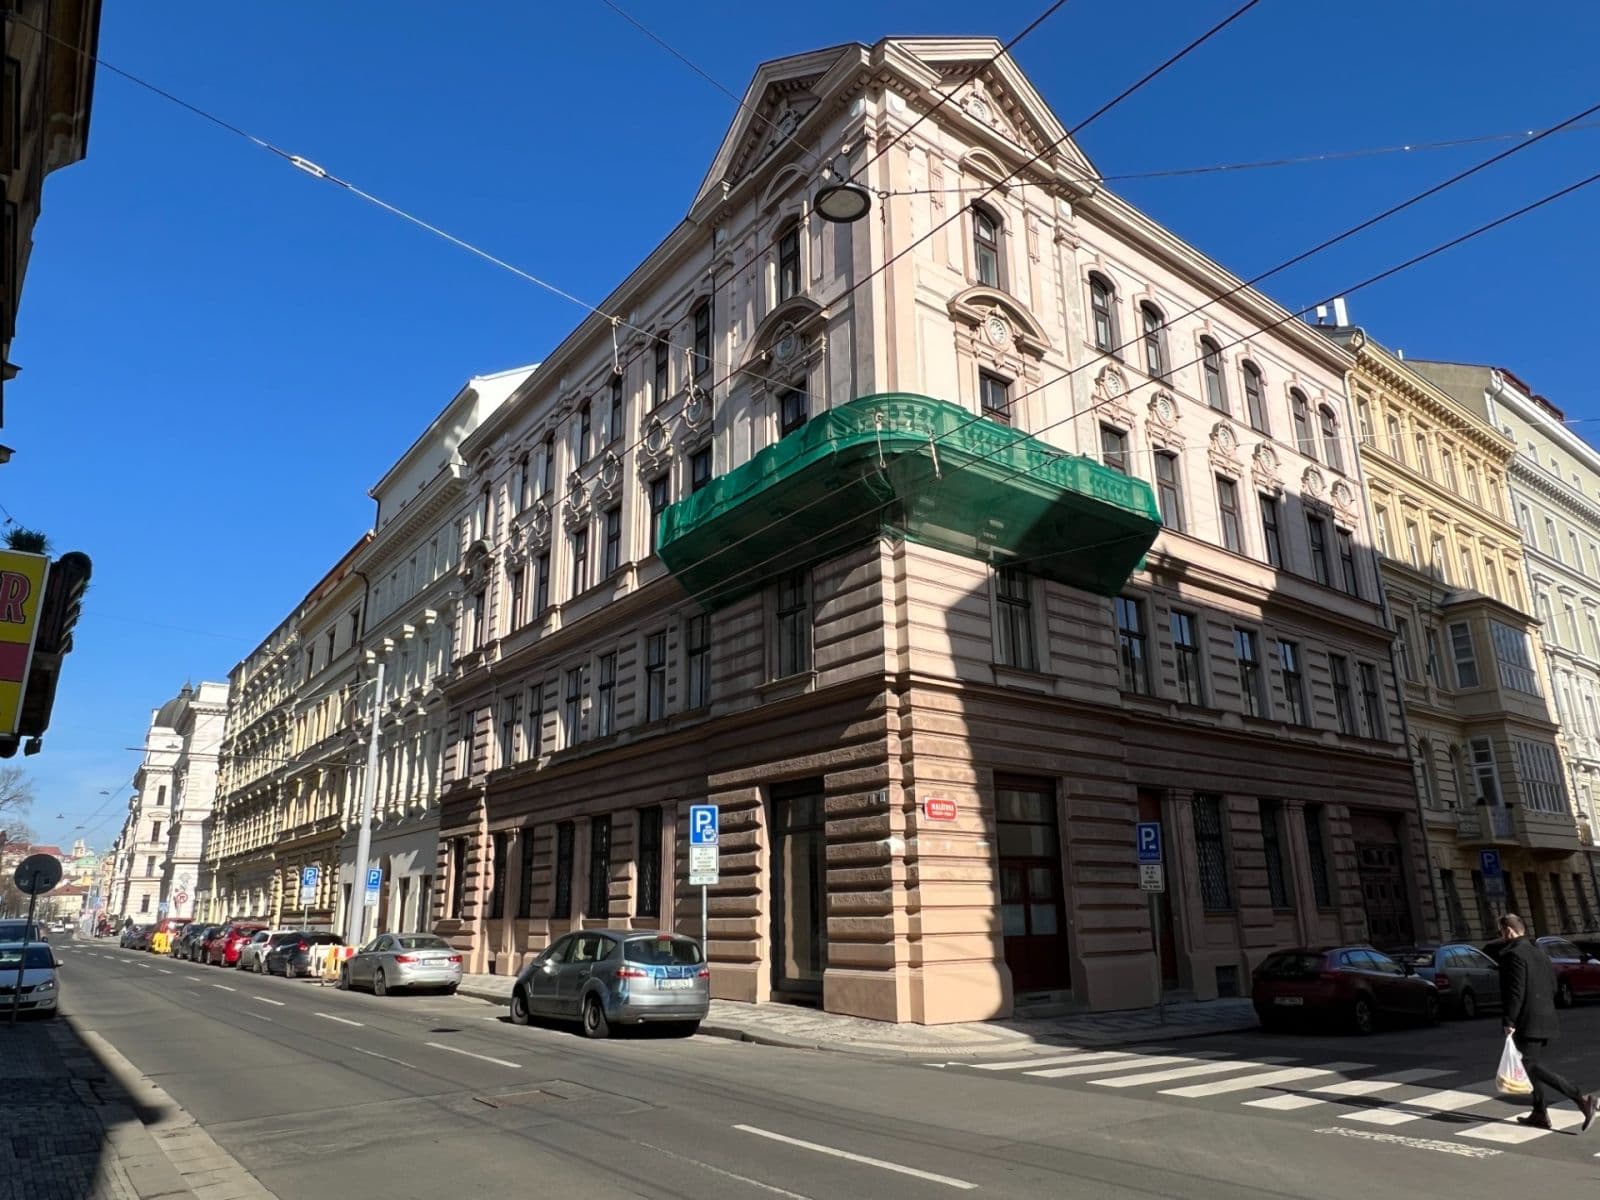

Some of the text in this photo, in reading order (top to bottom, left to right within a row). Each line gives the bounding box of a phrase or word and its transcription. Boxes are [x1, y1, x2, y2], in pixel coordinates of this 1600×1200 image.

[696, 810, 712, 833] P
[1141, 827, 1155, 850] P
[1483, 852, 1495, 869] P
[306, 870, 315, 881] P
[369, 871, 379, 884] P
